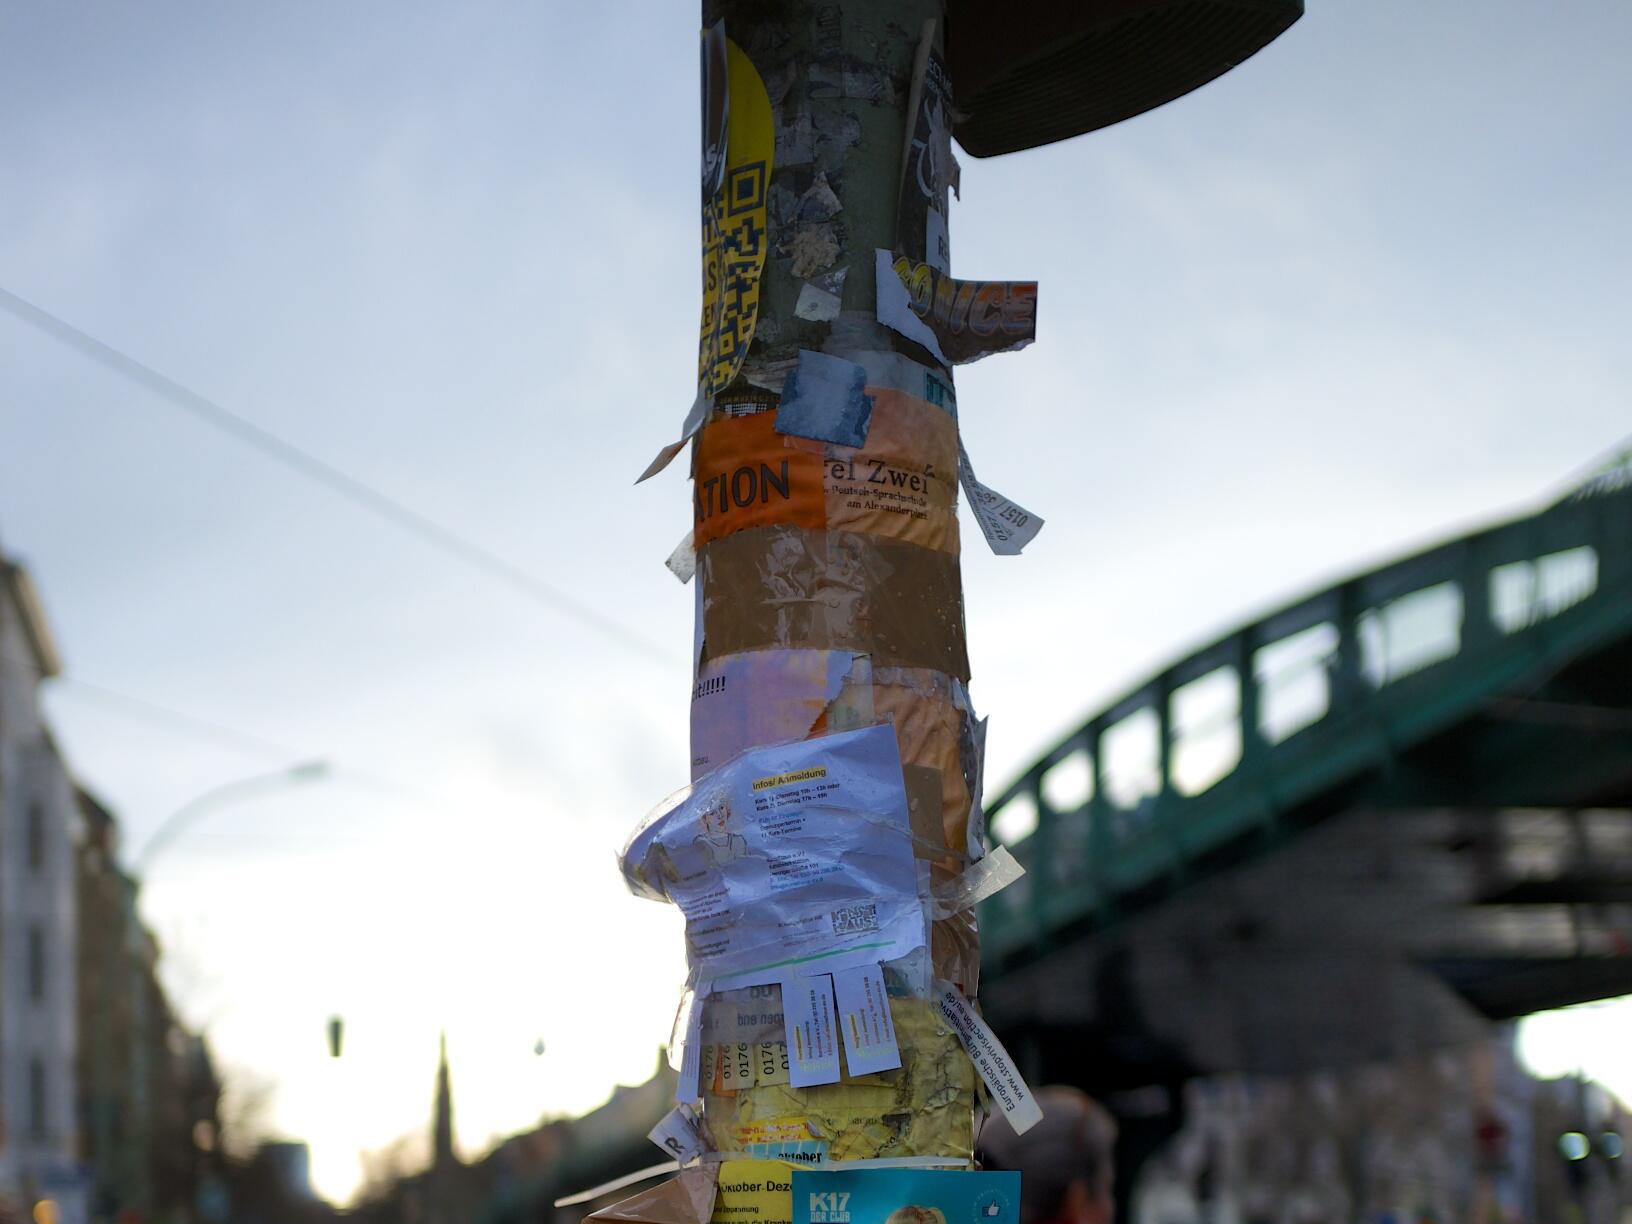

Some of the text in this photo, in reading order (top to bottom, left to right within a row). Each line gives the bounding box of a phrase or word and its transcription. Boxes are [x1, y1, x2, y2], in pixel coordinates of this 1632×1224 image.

[867, 459, 929, 495] Zwei
[739, 1042, 749, 1078] 0176
[763, 1040, 775, 1075] 0176
[779, 1040, 790, 1070] 017
[810, 1192, 851, 1211] K17
[810, 1211, 851, 1223] DER CLUB
